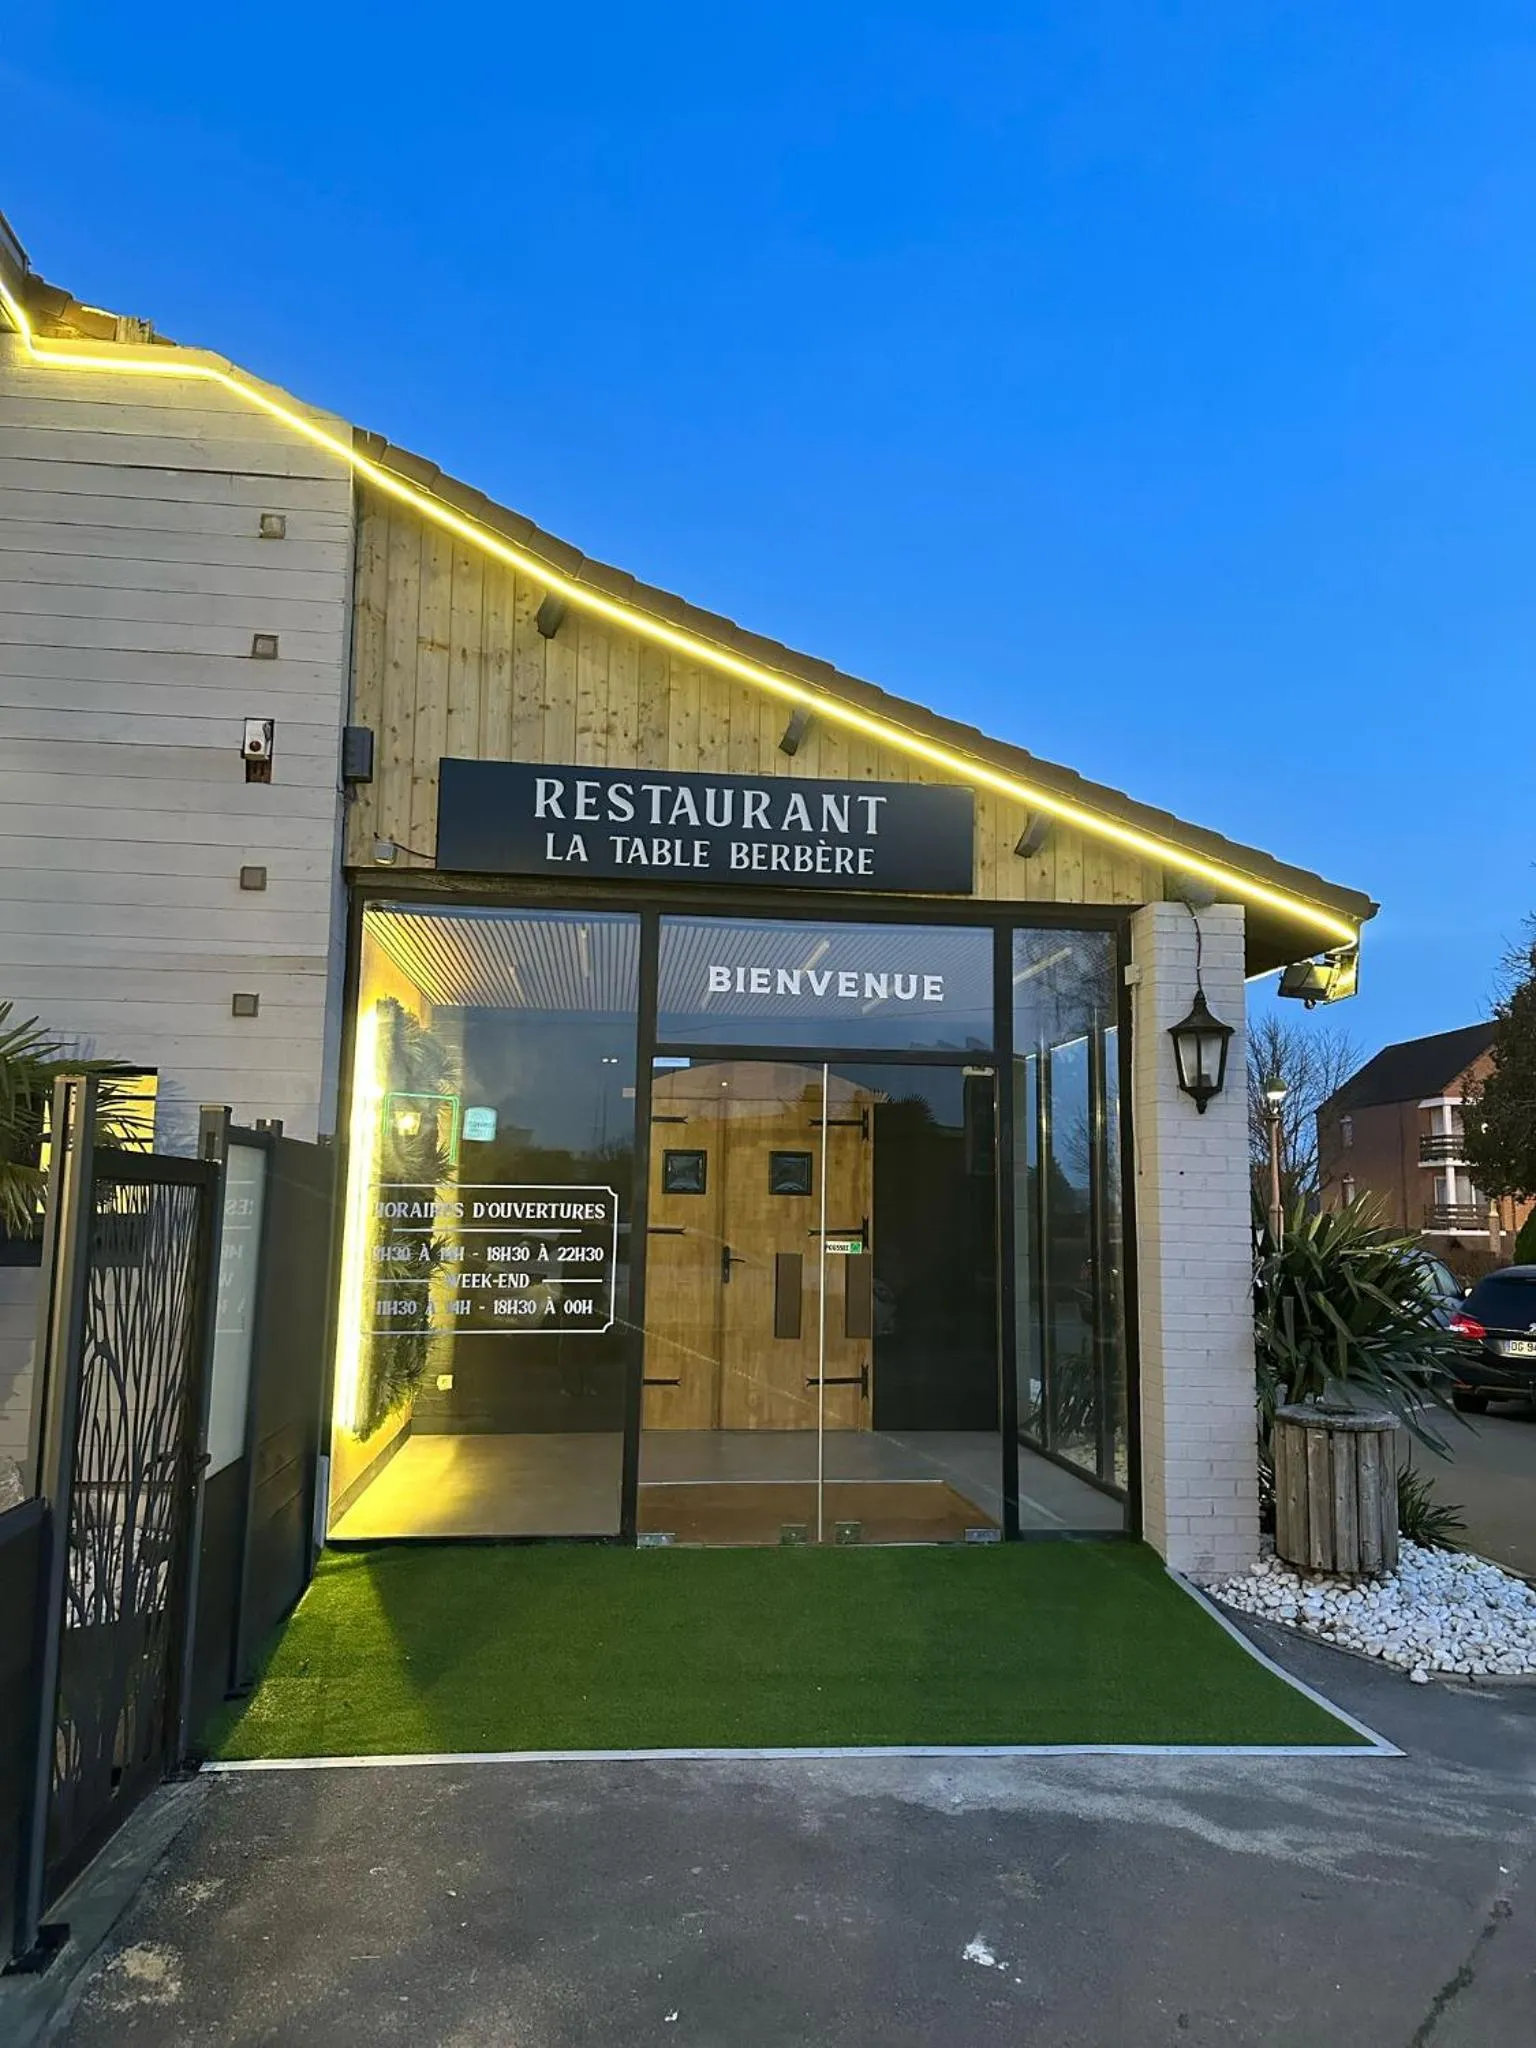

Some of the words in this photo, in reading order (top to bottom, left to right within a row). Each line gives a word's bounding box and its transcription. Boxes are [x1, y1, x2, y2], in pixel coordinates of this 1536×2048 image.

[534, 777, 887, 836] RESTAURANT
[545, 832, 588, 862] LA
[609, 836, 710, 868] TABLE
[730, 840, 875, 875] BERBÈRE
[708, 965, 944, 1001] BIENVENUE
[371, 1202, 464, 1218] HORAIRS
[473, 1202, 606, 1219] D'OUVERTURES
[486, 1246, 531, 1261] 18H30
[537, 1243, 550, 1261] À
[556, 1247, 604, 1261] 22H30
[493, 1299, 537, 1315] 18H30
[544, 1296, 556, 1315] À
[563, 1299, 593, 1315] 00H
